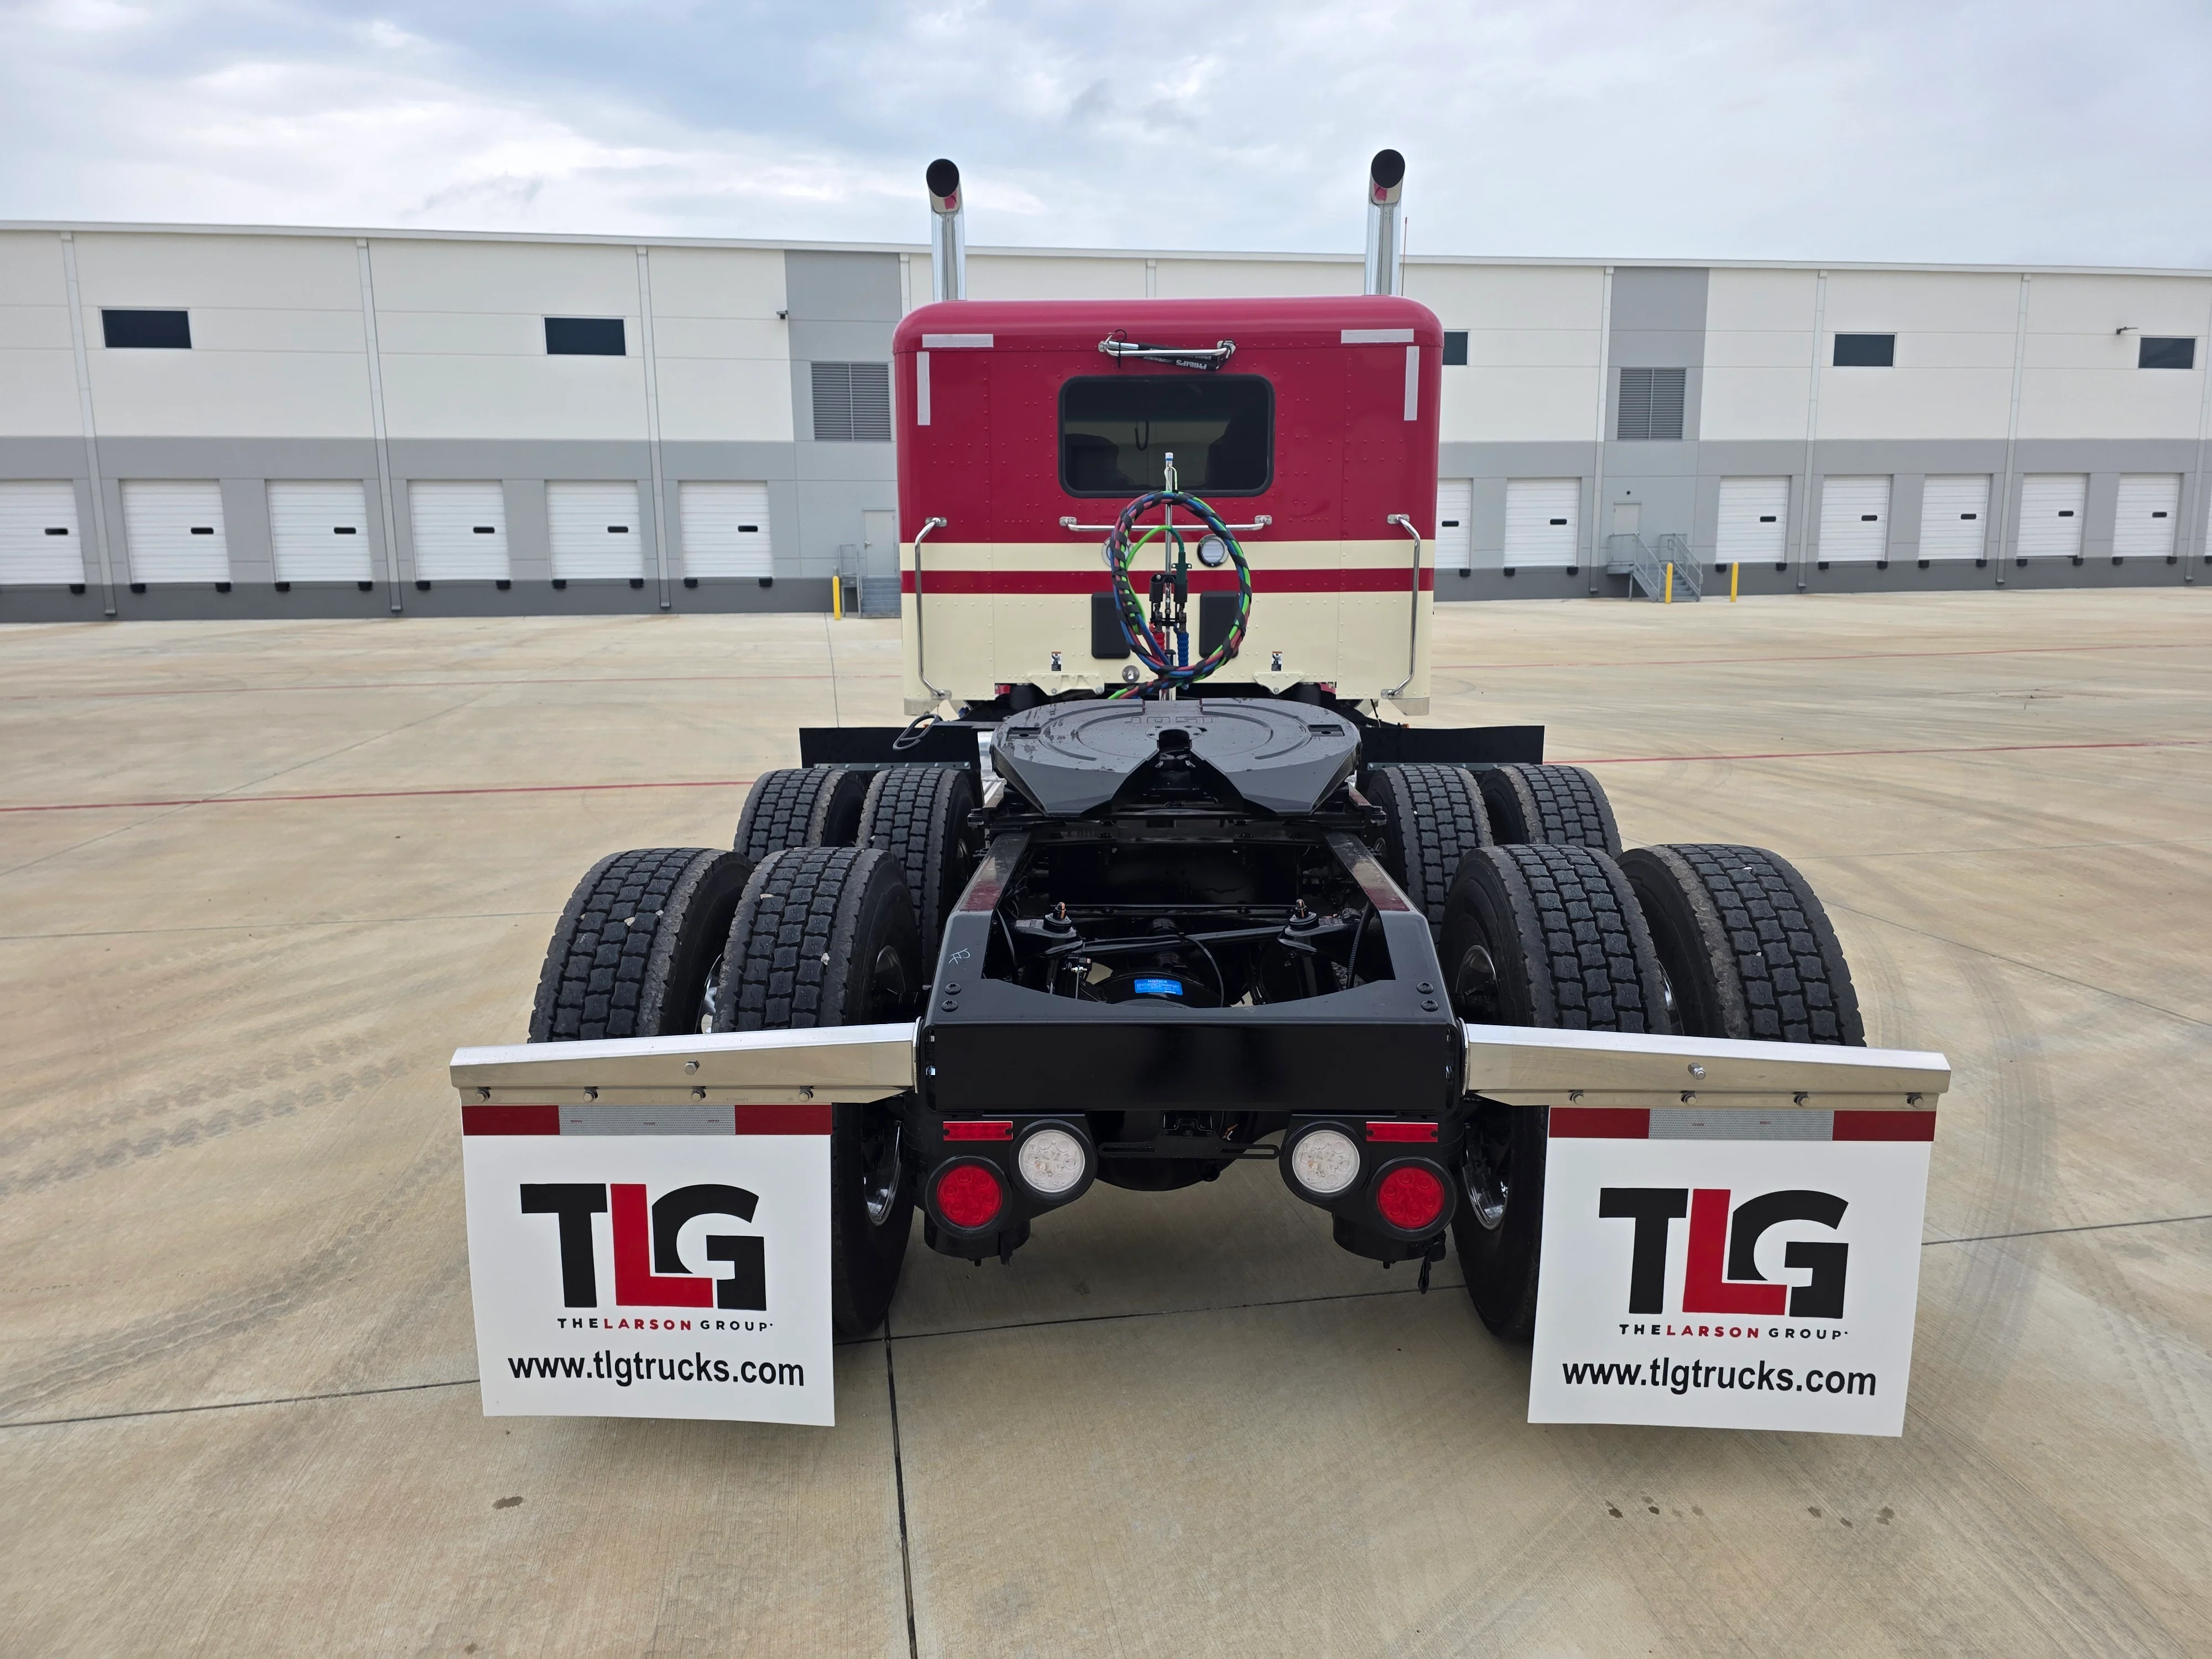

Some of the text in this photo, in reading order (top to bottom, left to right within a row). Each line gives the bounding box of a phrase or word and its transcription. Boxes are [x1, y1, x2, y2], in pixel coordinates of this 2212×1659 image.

[520, 1183, 767, 1311] TLG
[1599, 1187, 1849, 1319] TLG
[700, 1320, 767, 1332] GROUP
[1768, 1328, 1841, 1340] GROUP
[507, 1350, 804, 1387] www.tlgtrucks.com
[1562, 1357, 1876, 1396] www.tlgtrucks.com
